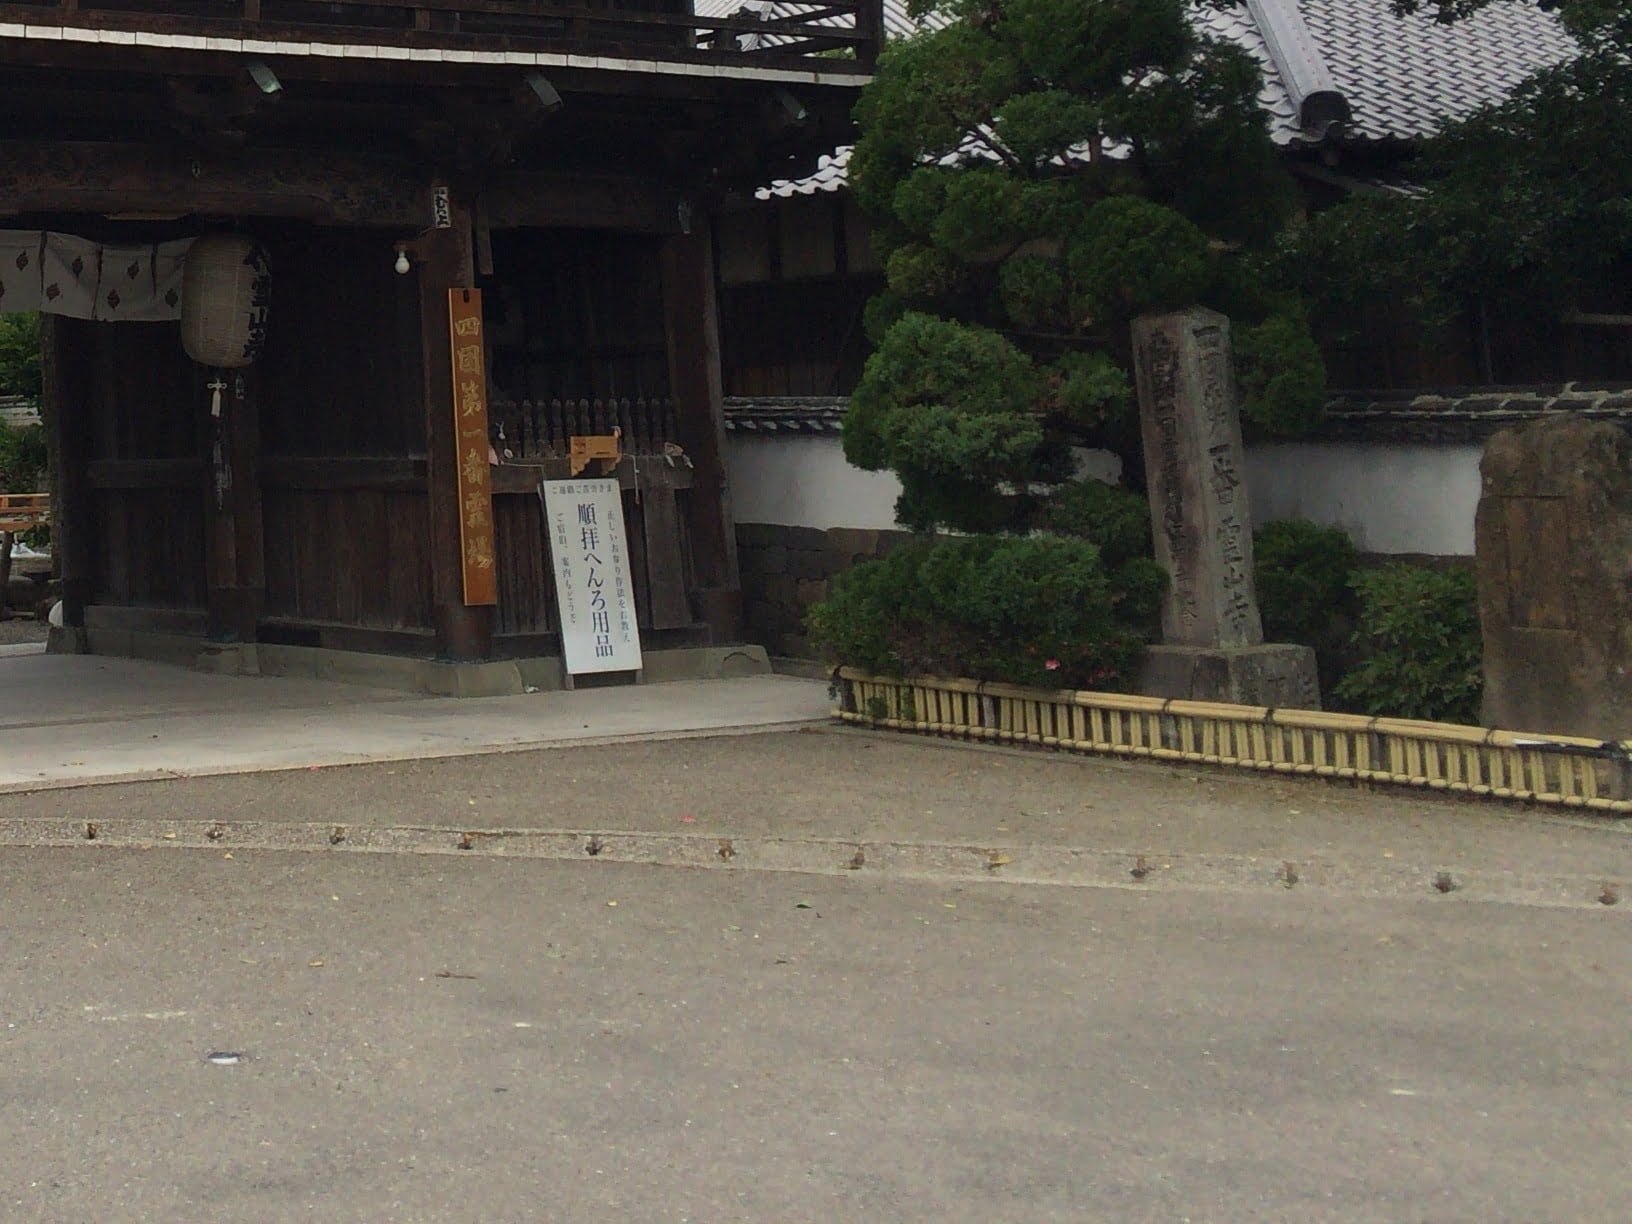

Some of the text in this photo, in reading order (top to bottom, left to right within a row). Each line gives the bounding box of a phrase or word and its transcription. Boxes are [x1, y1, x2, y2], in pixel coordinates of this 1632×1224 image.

[577, 502, 614, 658] 順拝へんろ用品
